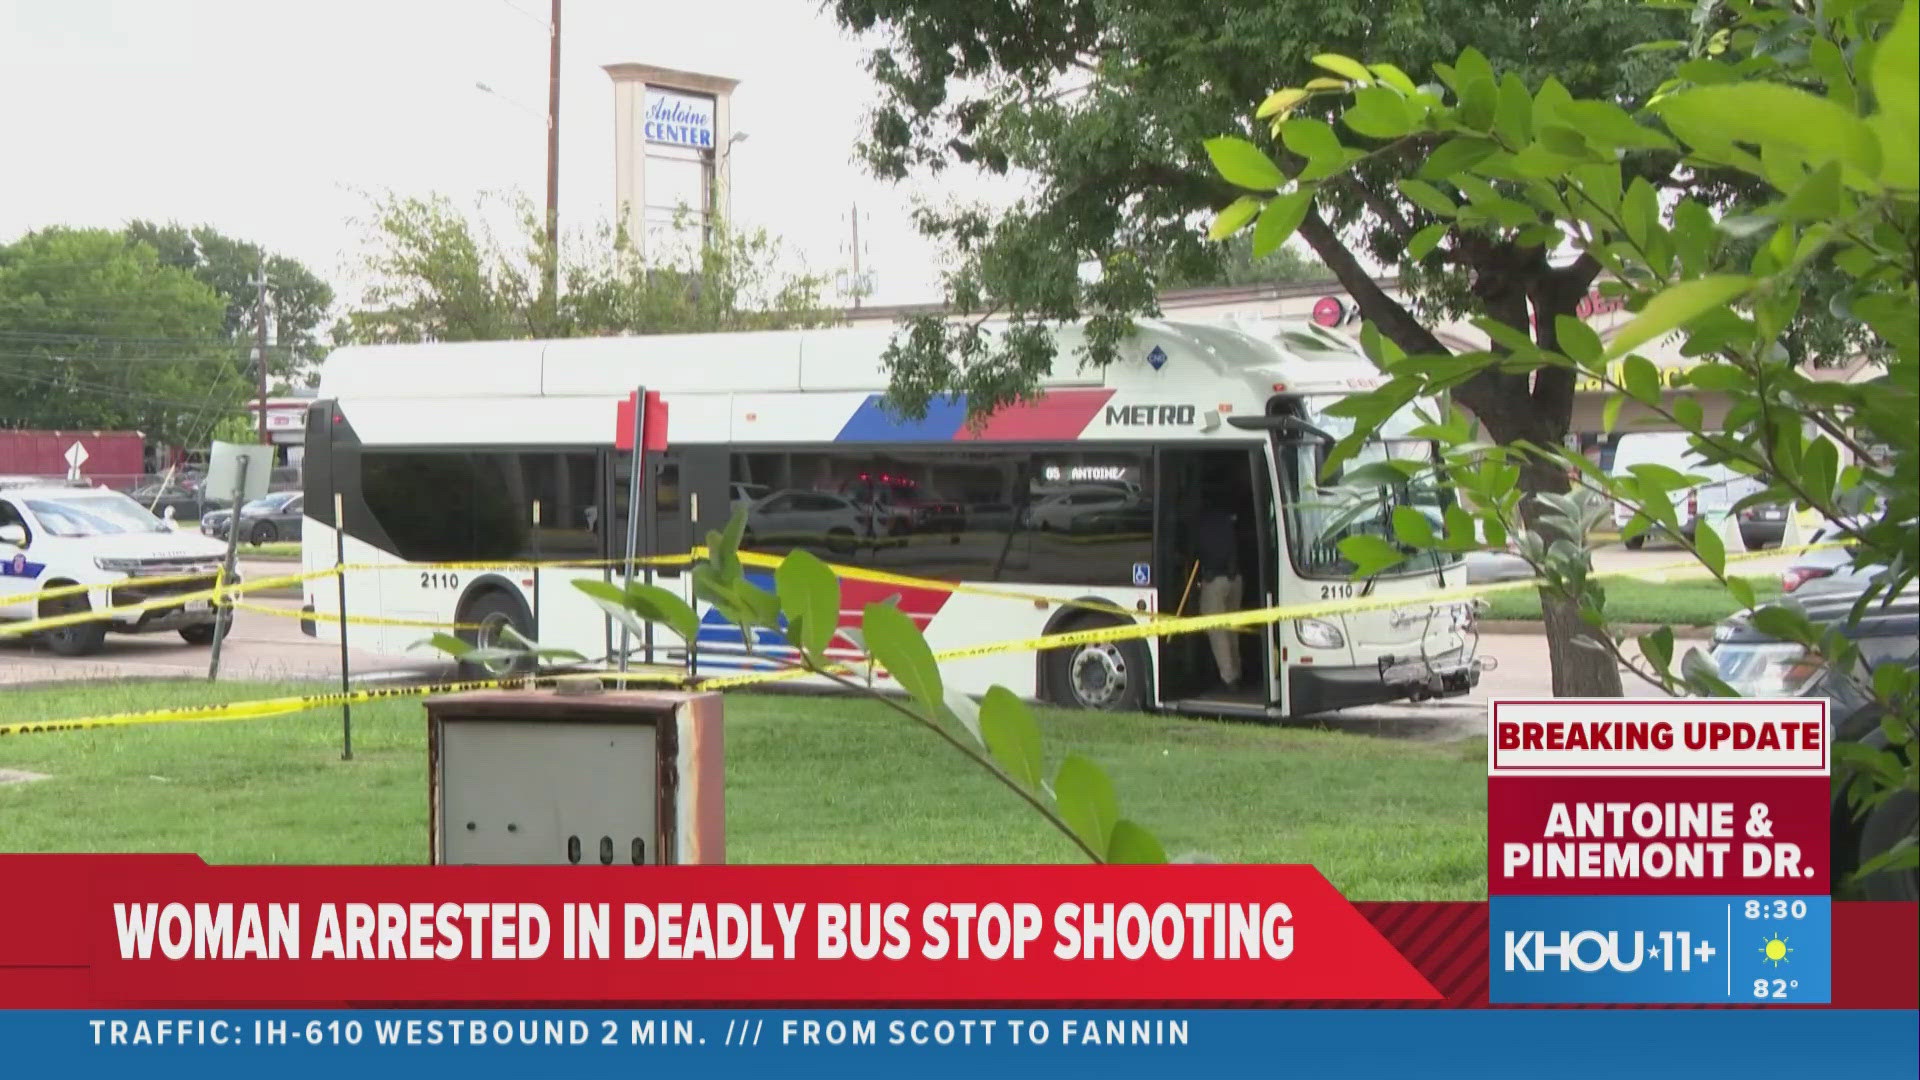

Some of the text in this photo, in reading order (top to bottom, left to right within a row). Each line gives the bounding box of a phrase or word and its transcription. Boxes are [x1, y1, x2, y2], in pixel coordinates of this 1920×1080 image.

[645, 96, 709, 127] Antoine
[645, 122, 711, 146] CENTER
[1106, 404, 1196, 426] METRO
[420, 572, 459, 589] 2110
[1321, 585, 1353, 599] 2110
